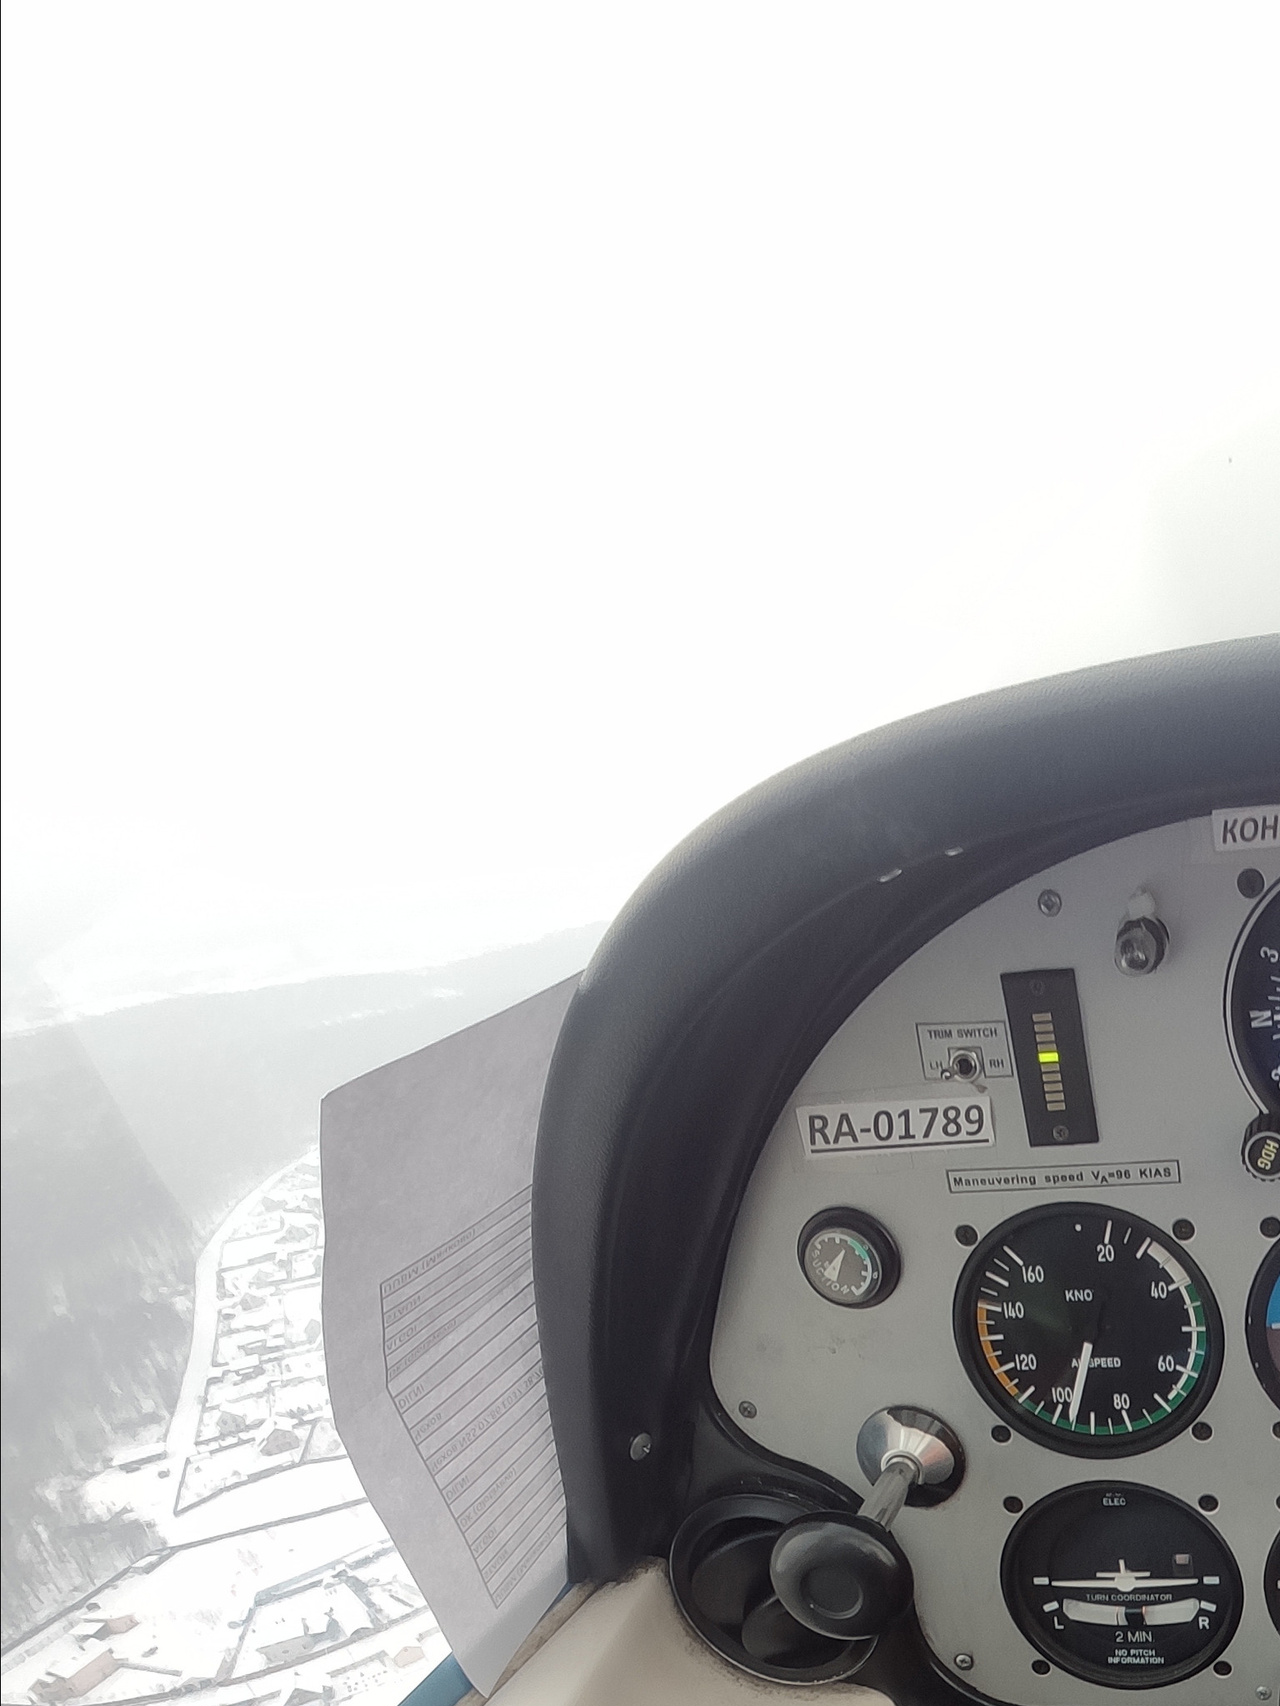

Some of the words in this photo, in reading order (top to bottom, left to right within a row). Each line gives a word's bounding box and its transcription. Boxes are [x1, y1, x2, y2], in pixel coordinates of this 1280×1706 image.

[1249, 1010, 1272, 1028] N
[927, 1029, 953, 1040] TRIM
[957, 1027, 998, 1039] SWITCH
[989, 1058, 1005, 1069] RH
[808, 1104, 985, 1146] RA-01789
[1257, 1138, 1279, 1170] HDG
[953, 1173, 1037, 1189] Maneuvering
[1044, 1171, 1084, 1185] speed
[1139, 1166, 1172, 1180] KIAS
[1096, 1245, 1115, 1262] 20
[1021, 1265, 1044, 1283] 160
[1150, 1281, 1167, 1299] 40
[1003, 1302, 1024, 1319] 140
[1015, 1353, 1037, 1371] 120
[1158, 1355, 1175, 1372] 60
[1113, 1393, 1130, 1410] 80
[1102, 1498, 1126, 1506] ELEC
[1086, 1593, 1109, 1602] TURN
[1111, 1593, 1172, 1602] COORDINATOR
[1054, 1616, 1064, 1630] L
[1199, 1616, 1210, 1630] R
[1107, 1656, 1164, 1665] INFORMATION
[1115, 1649, 1128, 1657] NO
[1130, 1649, 1155, 1657] PITCH
